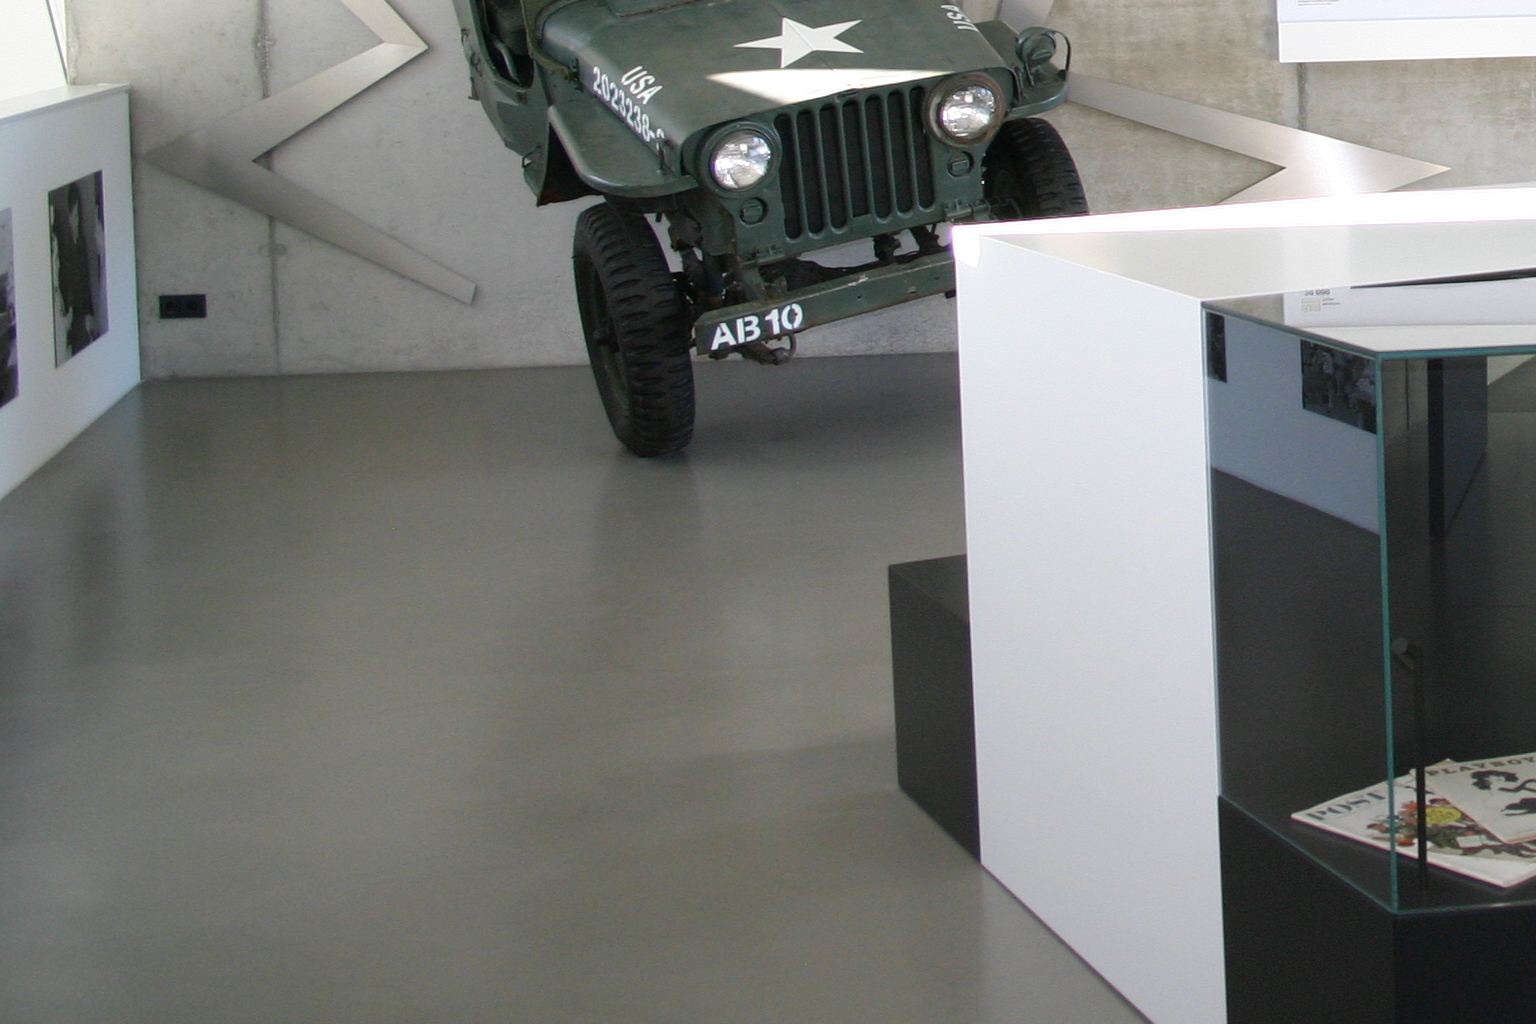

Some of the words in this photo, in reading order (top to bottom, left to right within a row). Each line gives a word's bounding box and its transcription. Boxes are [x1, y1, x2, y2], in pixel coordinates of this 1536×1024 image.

[621, 65, 663, 104] USA
[710, 314, 761, 351] AB
[764, 303, 803, 335] 10
[1425, 756, 1536, 776] PLAYBOY
[1306, 790, 1386, 822] POST
